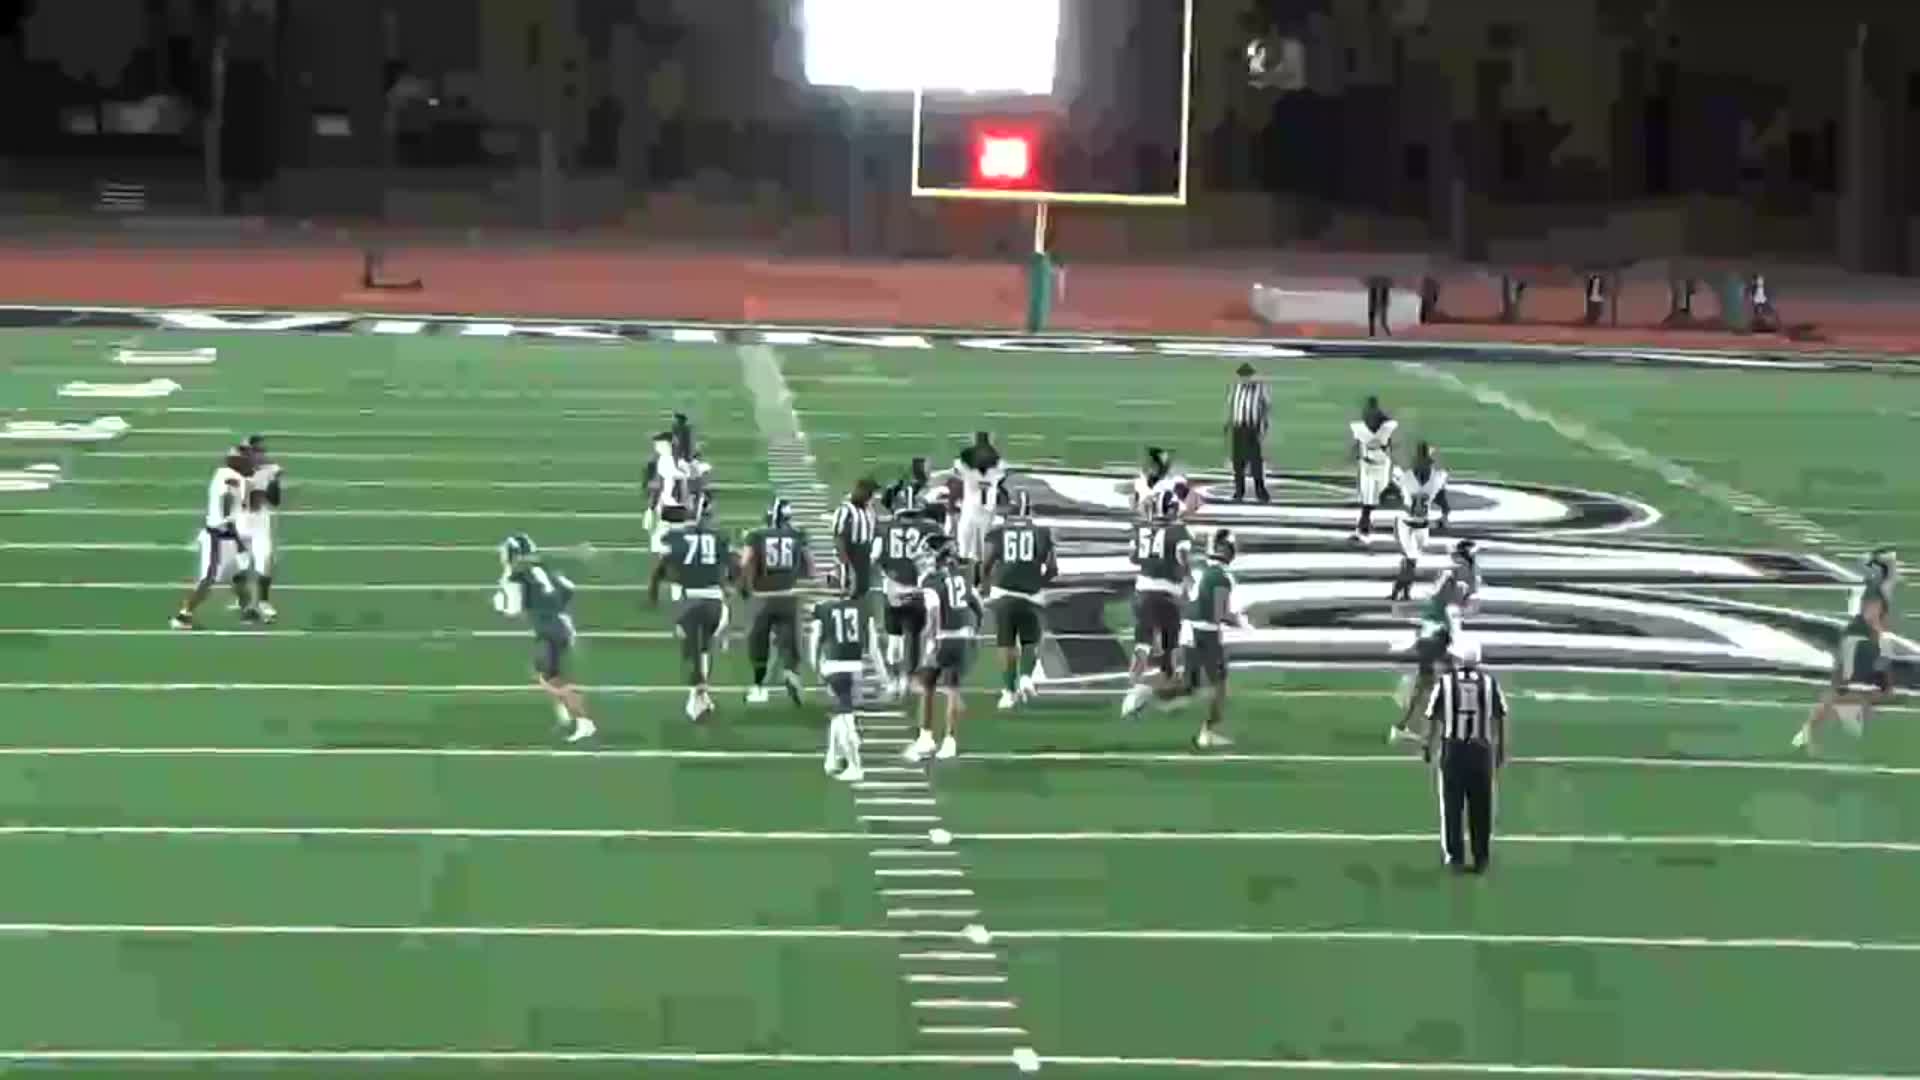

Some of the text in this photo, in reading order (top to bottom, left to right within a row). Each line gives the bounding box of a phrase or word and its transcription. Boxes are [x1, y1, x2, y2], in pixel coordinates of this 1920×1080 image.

[155, 310, 1308, 357] VIKINGS
[683, 534, 716, 565] 79
[889, 527, 921, 558] 62
[1003, 530, 1034, 562] 60
[1138, 526, 1166, 559] 54
[944, 575, 967, 609] 12
[831, 607, 859, 643] 13
